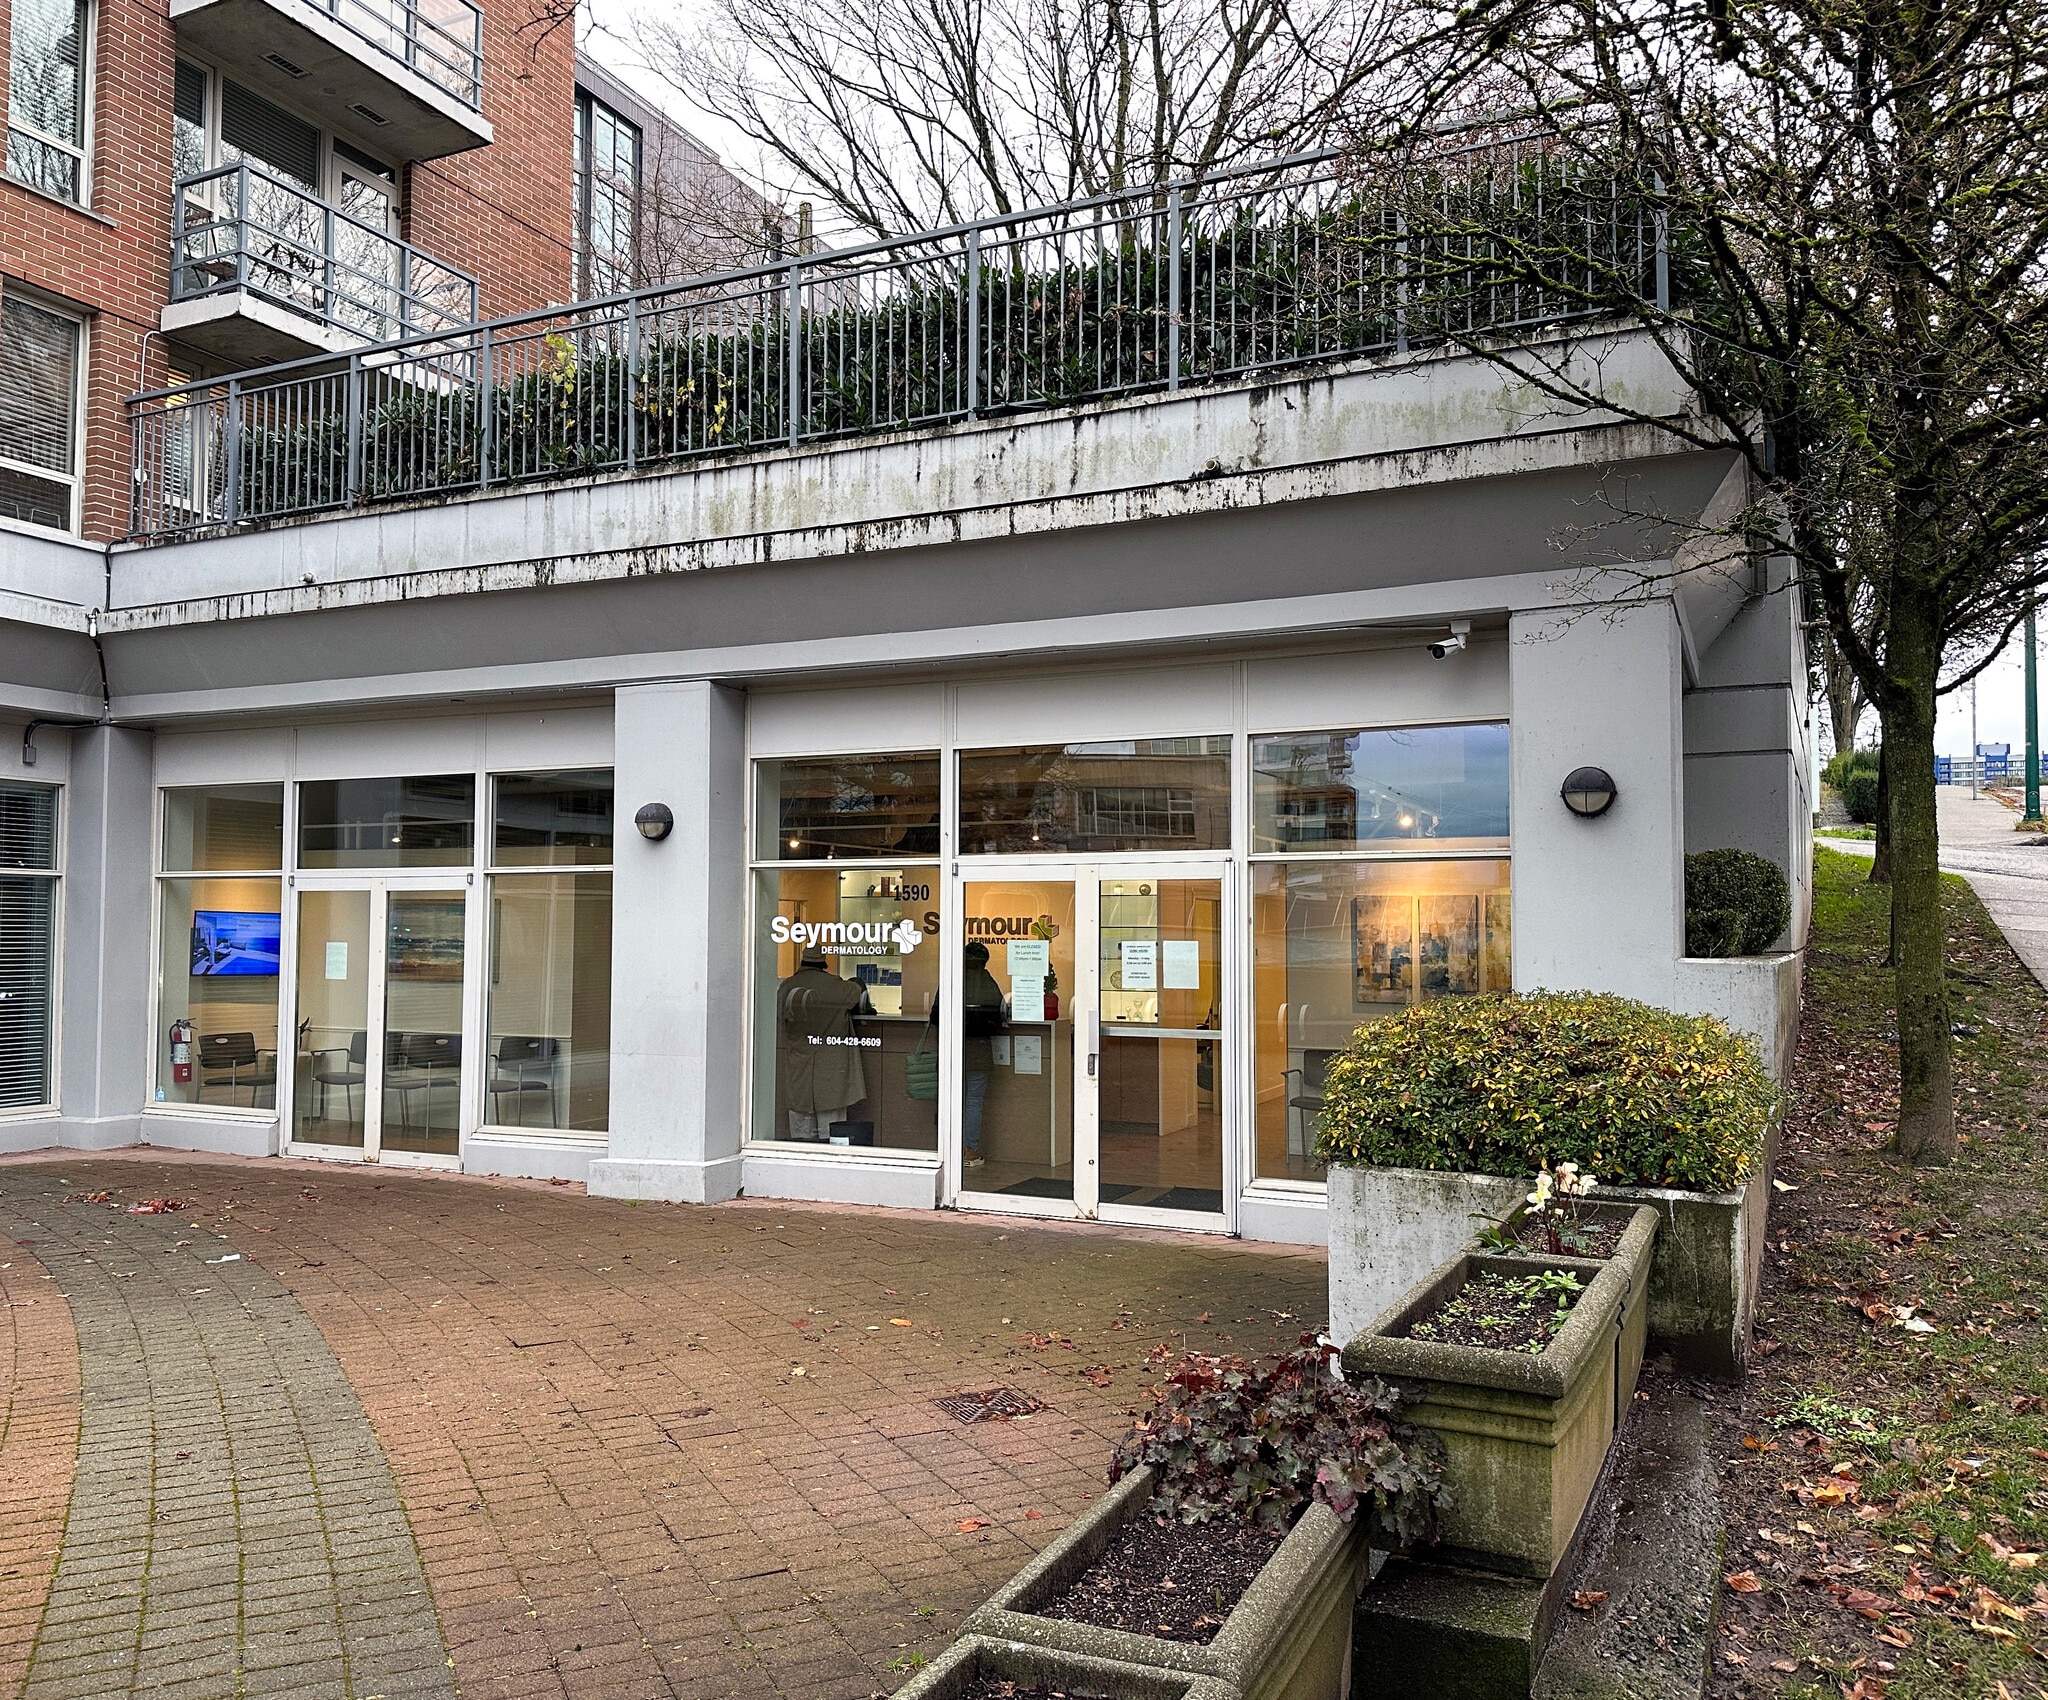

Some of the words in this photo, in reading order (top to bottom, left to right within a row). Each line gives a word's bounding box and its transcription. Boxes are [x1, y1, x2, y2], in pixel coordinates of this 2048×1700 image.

[893, 885, 929, 901] 1590
[923, 911, 1032, 936] Smour
[771, 916, 893, 948] Seymour
[821, 946, 888, 955] DERMATOLOGY
[807, 1035, 823, 1045] Tel:
[826, 1036, 881, 1047] 604-428-6609
